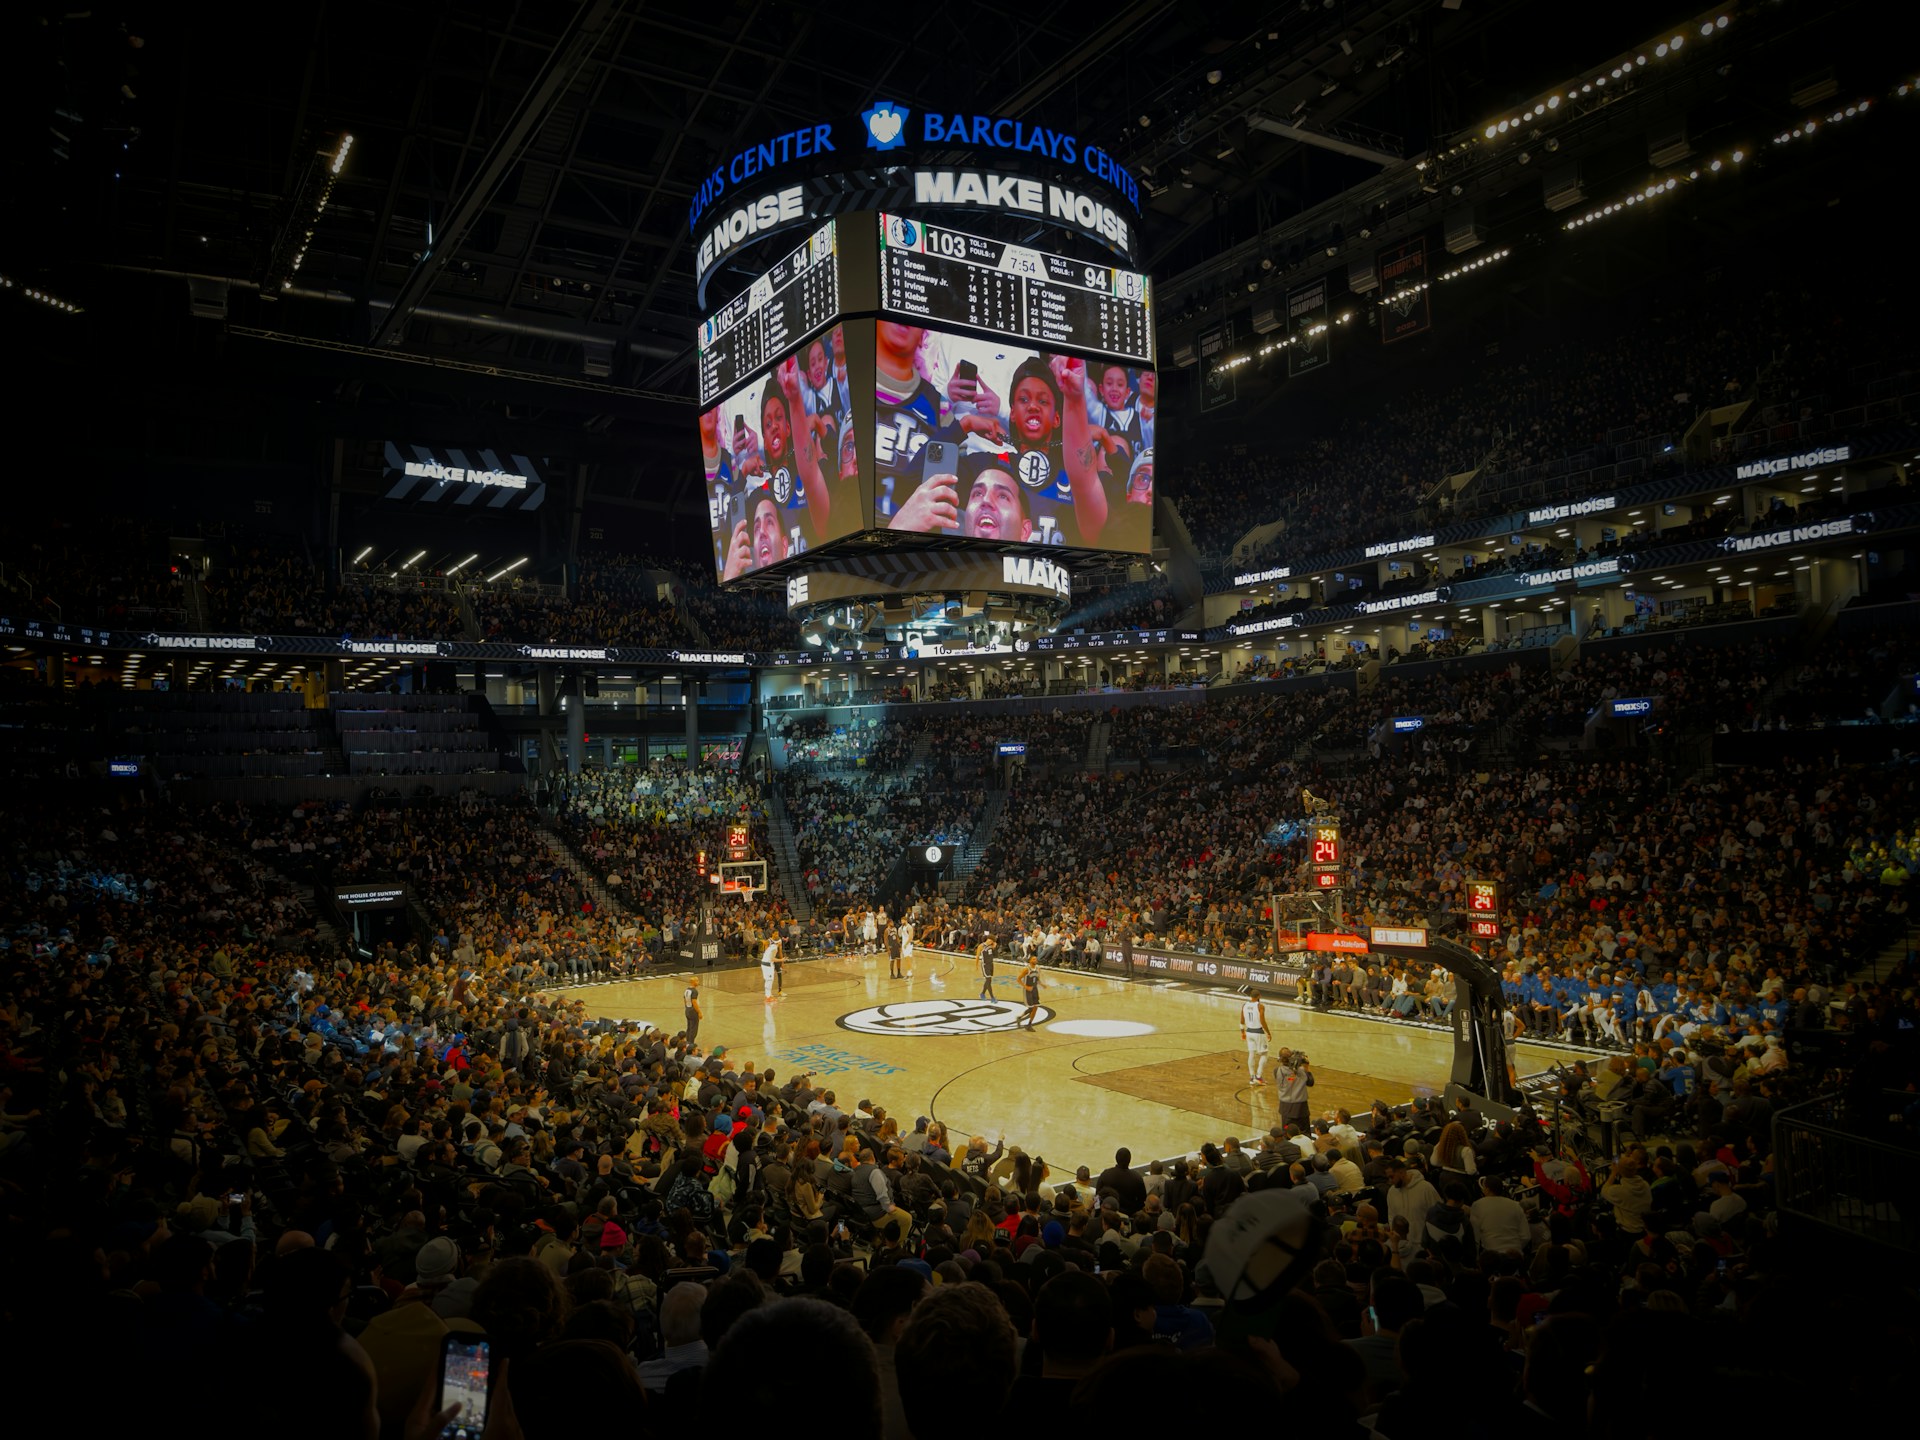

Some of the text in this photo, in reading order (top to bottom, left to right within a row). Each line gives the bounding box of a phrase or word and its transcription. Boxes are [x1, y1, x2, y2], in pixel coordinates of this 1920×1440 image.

[730, 124, 836, 184] CENTER
[923, 113, 1140, 215] BARCLAYS CENTER
[714, 186, 804, 258] NOISE
[914, 172, 1128, 252] MAKE NOISE
[929, 230, 966, 258] 103
[793, 247, 807, 275] 94
[904, 260, 925, 271] Green
[1010, 257, 1036, 274] 7:54
[892, 268, 900, 276] 10
[904, 270, 938, 284] Hardaway
[968, 284, 977, 292] 14
[1084, 267, 1107, 290] 94
[892, 278, 900, 287] 11
[904, 281, 925, 294] Irving
[968, 295, 977, 303] 30
[892, 289, 901, 297] 42
[904, 291, 928, 303] Kleber
[1029, 287, 1038, 296] 00
[892, 299, 901, 308] 77
[905, 302, 930, 314] Doncic
[969, 316, 978, 324] 32
[996, 320, 1004, 329] 14
[1042, 300, 1066, 311] Bridges
[1042, 310, 1064, 320] Wilson
[717, 306, 733, 334] 103
[1042, 320, 1074, 332] Dinwiddie
[1042, 330, 1067, 341] Claxton
[1736, 446, 1849, 480] MAKE NOISE
[404, 462, 527, 488] MAKE NOISE
[1529, 496, 1615, 523] MAKE NOISE
[1736, 520, 1852, 552] MAKE NOISE
[1366, 536, 1434, 558] MAKE NOISE
[1002, 556, 1070, 596] MAKE
[1234, 567, 1290, 586] MAKE NOISE
[1530, 560, 1618, 586] MAKE NOISE
[1366, 591, 1437, 613] MAKE NOISE
[1236, 616, 1293, 636] MAKE NOISE
[158, 636, 256, 649] MAKE NOISE
[352, 642, 437, 654] MAKE NOISE
[531, 648, 606, 659] MAKE NOISE
[679, 653, 745, 663] MAKE NOISE
[731, 834, 744, 846] 24
[1319, 829, 1336, 841] 7:54
[1316, 842, 1335, 862] 24
[1475, 896, 1491, 909] 24
[1150, 959, 1168, 969] max
[1170, 958, 1193, 972] TUESDAYS
[1222, 964, 1247, 980] TUESDAYS
[1250, 972, 1270, 983] max
[796, 1044, 907, 1074] BARCLAYS
